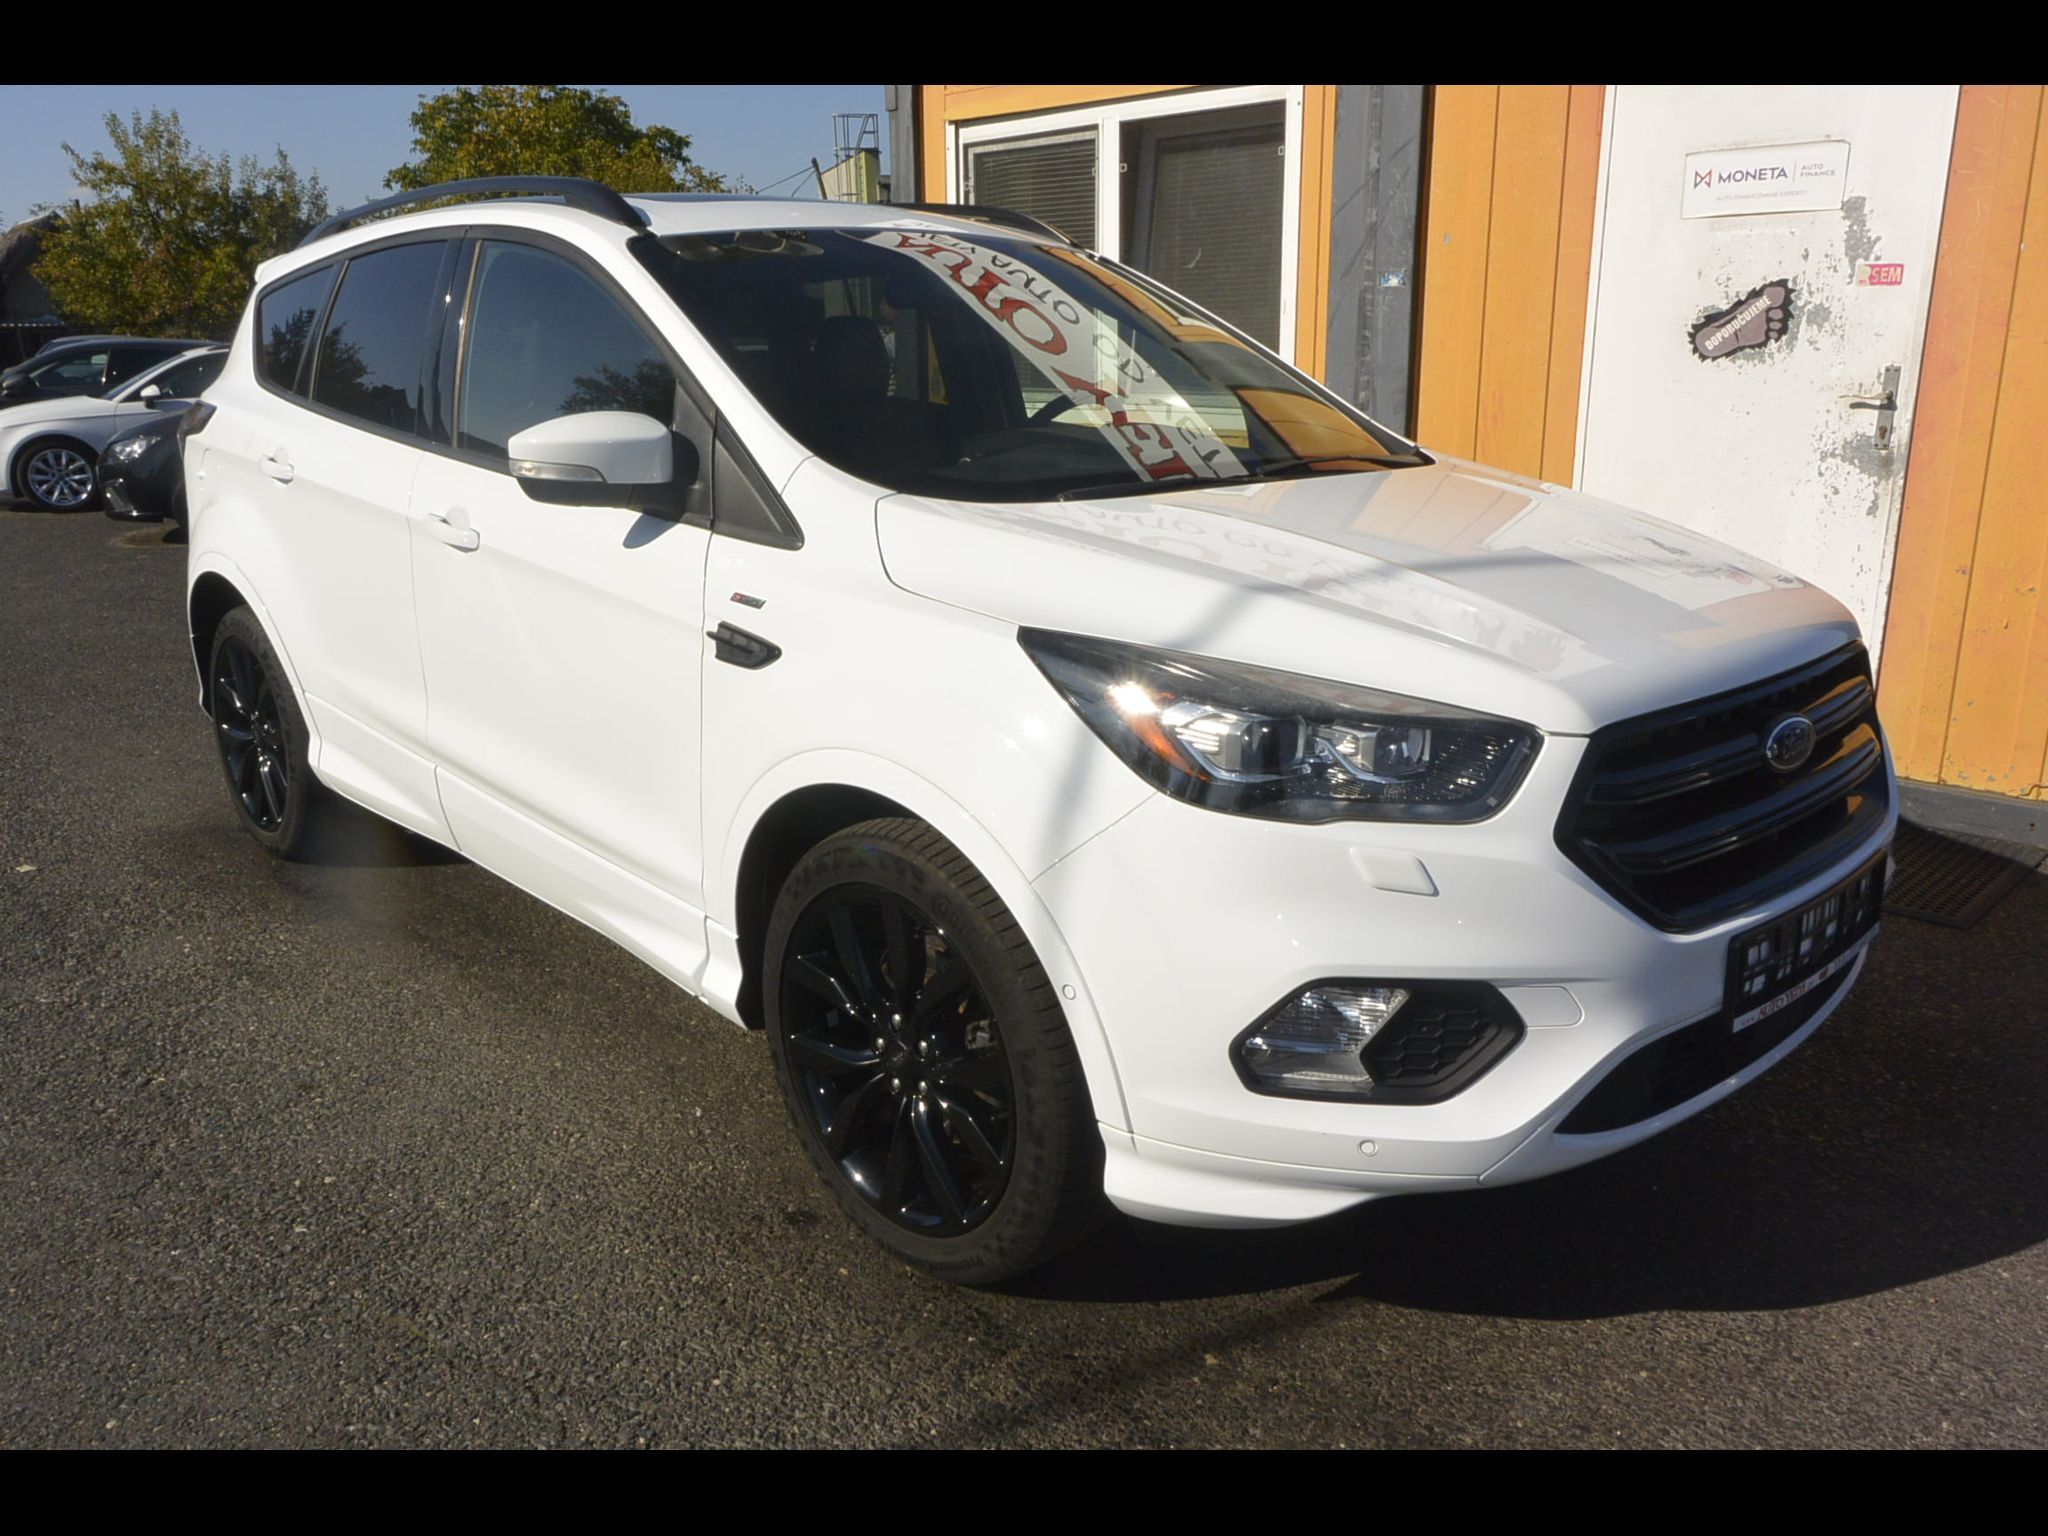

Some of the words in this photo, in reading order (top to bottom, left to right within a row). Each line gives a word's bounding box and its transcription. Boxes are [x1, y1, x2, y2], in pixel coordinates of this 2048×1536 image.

[1717, 166, 1788, 184] MONETA
[1800, 169, 1836, 178] FINANCE
[1801, 163, 1824, 171] AUTO
[1871, 267, 1902, 283] SEM
[1704, 295, 1772, 350] DOPORUČUJEME
